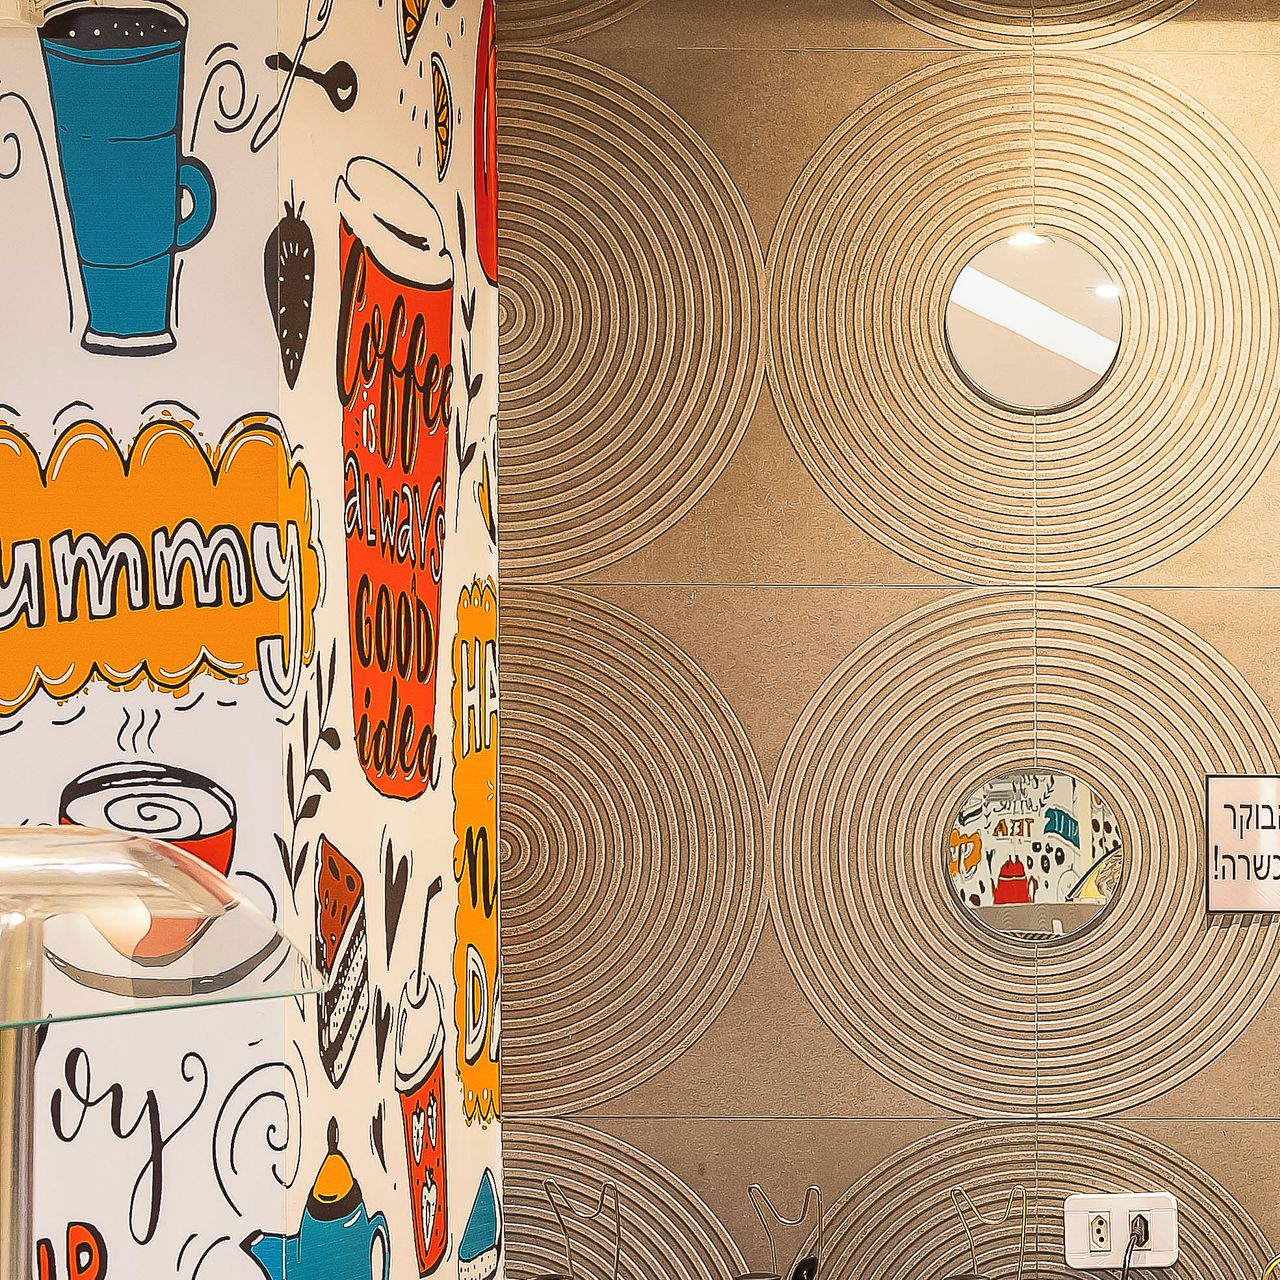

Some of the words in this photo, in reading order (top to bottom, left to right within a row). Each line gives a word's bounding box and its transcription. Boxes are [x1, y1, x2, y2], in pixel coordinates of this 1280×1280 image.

[336, 237, 453, 474] Coffee
[363, 390, 376, 453] is
[0, 518, 302, 709] ummy
[355, 573, 435, 684] GOOD
[354, 676, 441, 790] idea
[461, 638, 500, 759] HA
[46, 1042, 208, 1246] oy
